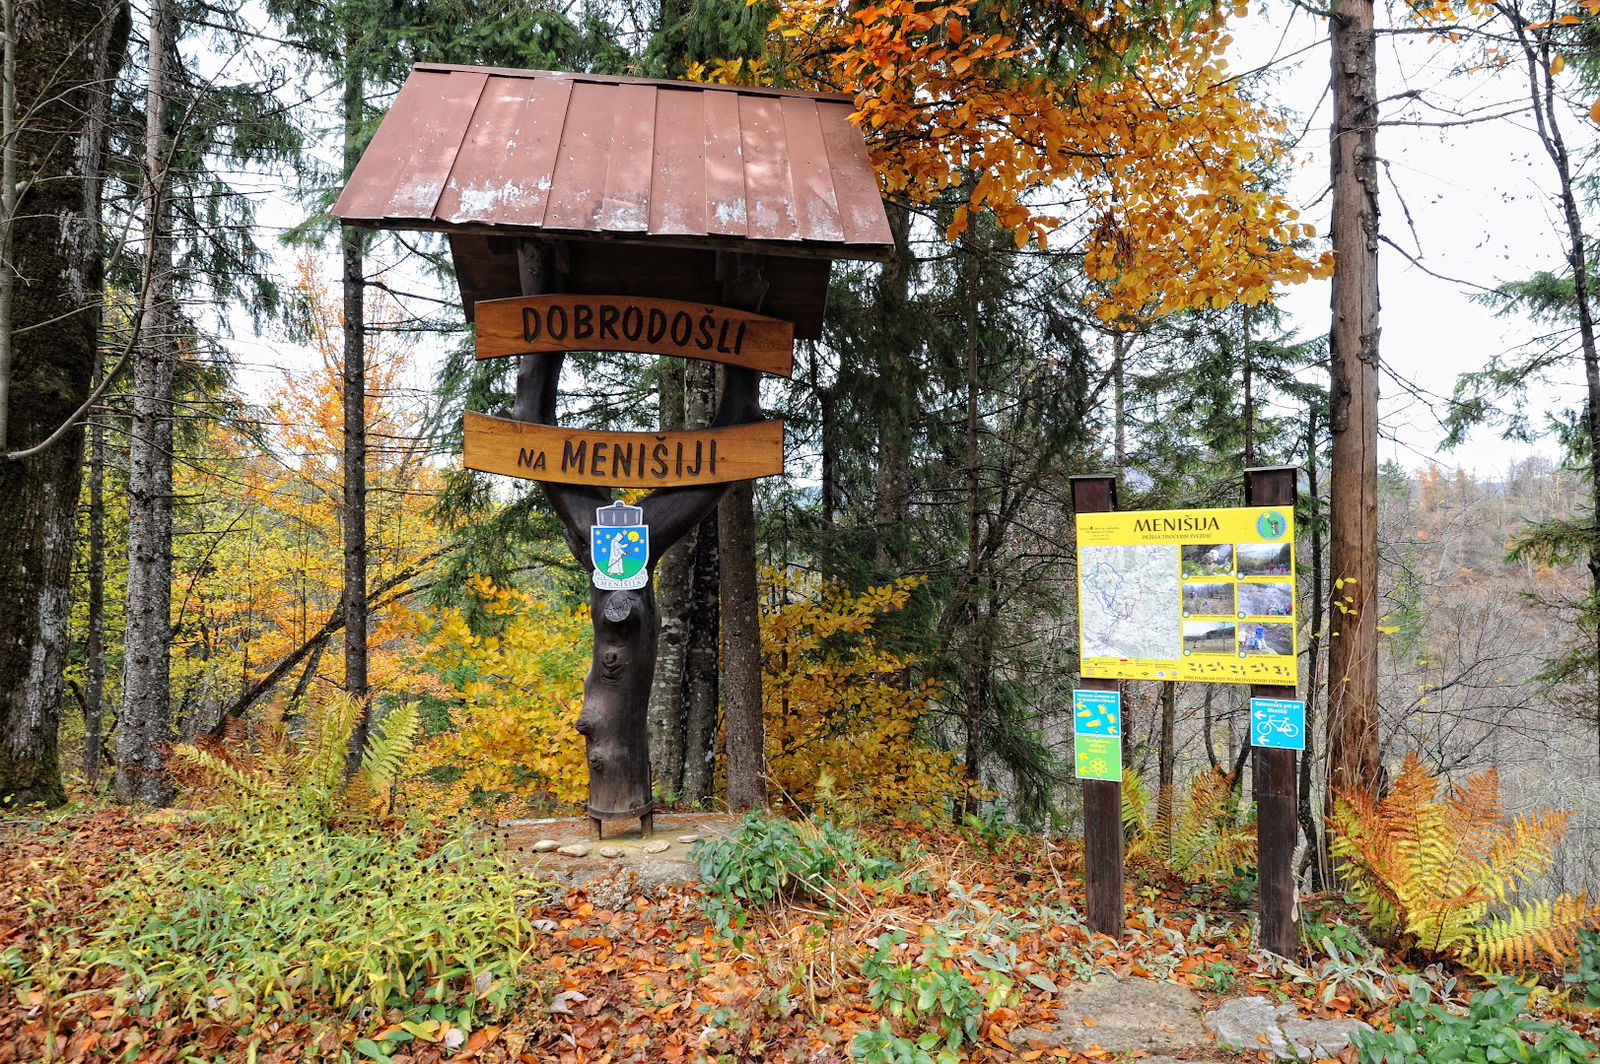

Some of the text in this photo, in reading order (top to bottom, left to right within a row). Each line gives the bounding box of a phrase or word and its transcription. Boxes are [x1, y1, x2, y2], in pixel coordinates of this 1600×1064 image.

[522, 304, 746, 355] DOBRODOŠLI
[517, 436, 717, 479] NA MENIŠIJI
[1133, 514, 1220, 532] MENIŠIJA
